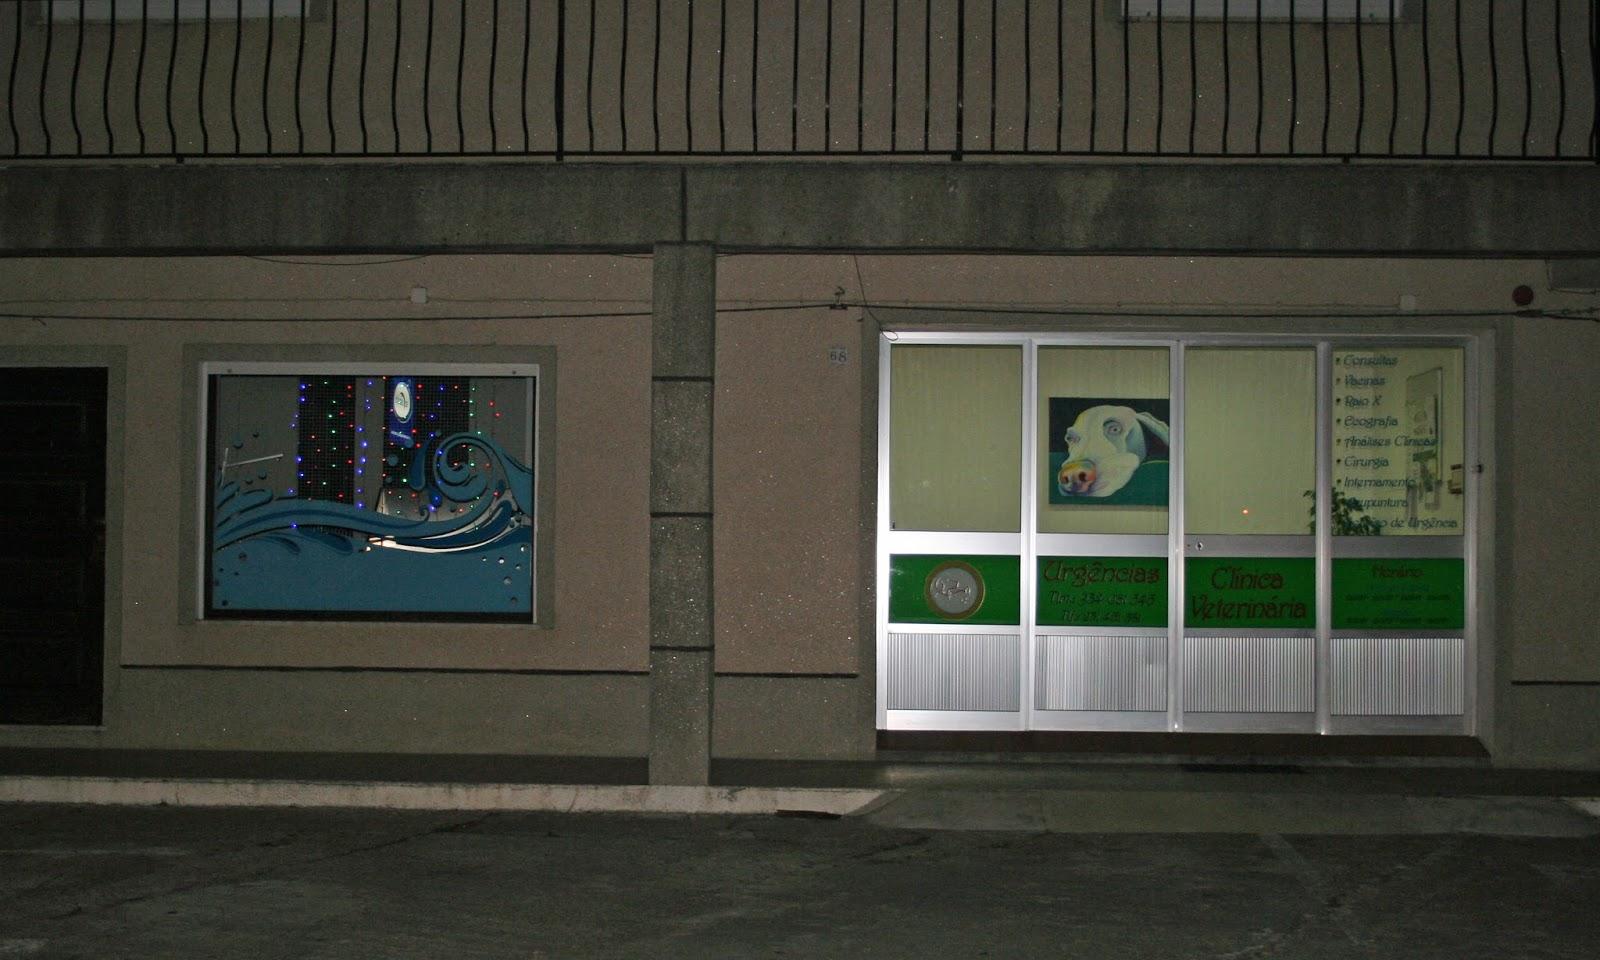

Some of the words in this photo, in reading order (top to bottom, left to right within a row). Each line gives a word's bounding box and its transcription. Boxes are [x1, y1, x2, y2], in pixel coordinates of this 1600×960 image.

[1343, 355, 1398, 367] Consultas
[1344, 375, 1386, 386] Vacinas
[1344, 396, 1369, 407] Raio
[1372, 395, 1382, 406] X
[1344, 415, 1398, 429] Ecografia
[1344, 436, 1391, 448] Análises
[1344, 456, 1389, 469] Cirurgia
[1344, 477, 1416, 489] Internamento
[1390, 518, 1405, 528] de
[1043, 560, 1160, 587] Urgências
[1211, 566, 1284, 590] Clínica
[1191, 594, 1307, 621] Veterinária
